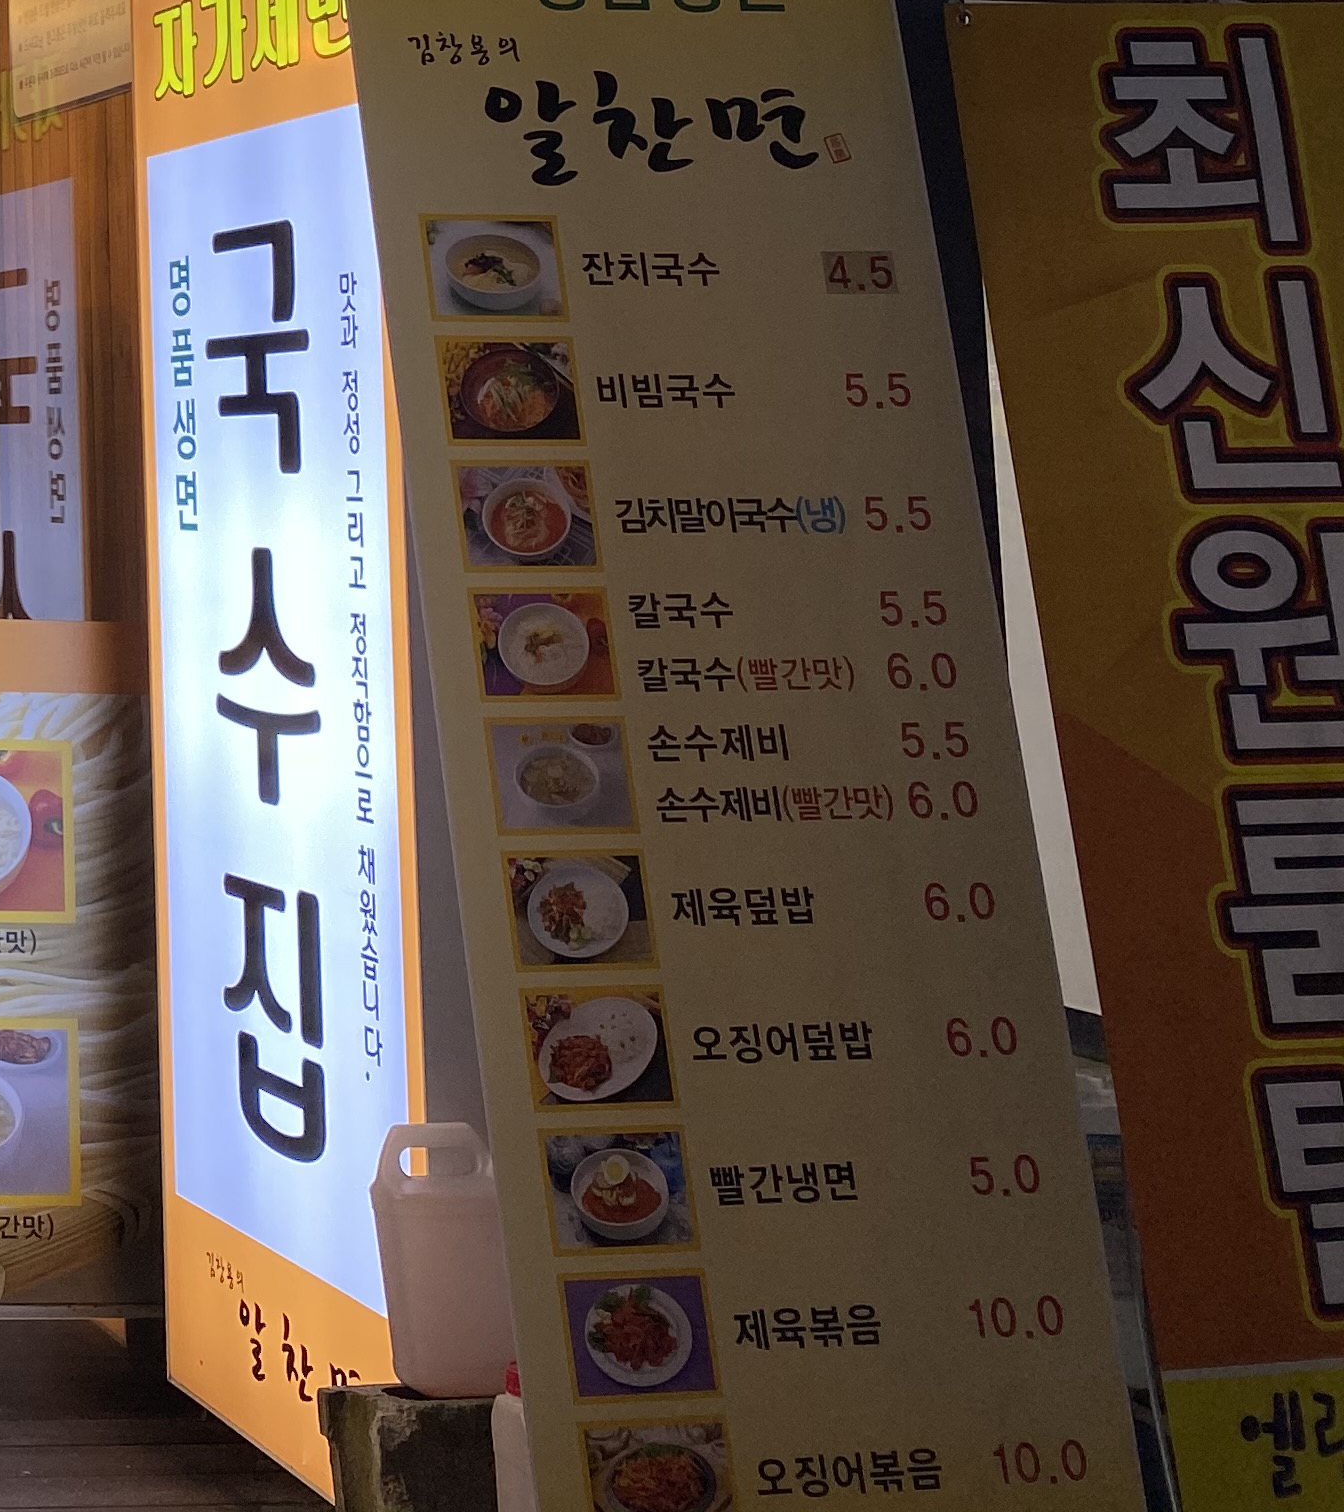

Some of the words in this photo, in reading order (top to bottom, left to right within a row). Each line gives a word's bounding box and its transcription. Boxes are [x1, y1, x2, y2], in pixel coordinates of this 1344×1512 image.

[580, 250, 721, 287] 잔치국수
[827, 254, 894, 291] 4.5
[338, 271, 360, 350] 맛과
[169, 255, 199, 532] 명품생면
[341, 369, 361, 455] 정성
[596, 372, 737, 409] 비빔국수
[843, 372, 912, 409] 5.5
[345, 468, 367, 590] 그리고
[614, 496, 847, 537] 김치말이국수(냉)
[864, 496, 933, 533] 5.5
[627, 592, 735, 629] 칼국수
[879, 589, 949, 629] 5.5
[205, 219, 327, 1163] 국수집
[636, 654, 855, 694] 칼국수(빨간맛)
[887, 652, 958, 692] 6.0
[349, 611, 376, 826] 정직함으로
[646, 723, 791, 762] 손수제비
[900, 722, 970, 760] 5.5
[655, 784, 894, 824] 손수제비(빨간맛)
[907, 780, 978, 821] 6.0
[670, 886, 815, 926] 제육덮밥
[923, 882, 996, 923] 6.0
[692, 1019, 874, 1064] 오징어덮밥
[945, 1016, 1018, 1059] 6.0
[709, 1160, 859, 1207] 빨간냉면
[969, 1153, 1042, 1196] 5.0
[732, 1302, 882, 1350] 제육볶음
[968, 1294, 1065, 1341] 10.0
[757, 1447, 944, 1498] 오징어볶음
[992, 1438, 1088, 1486] 10.0
